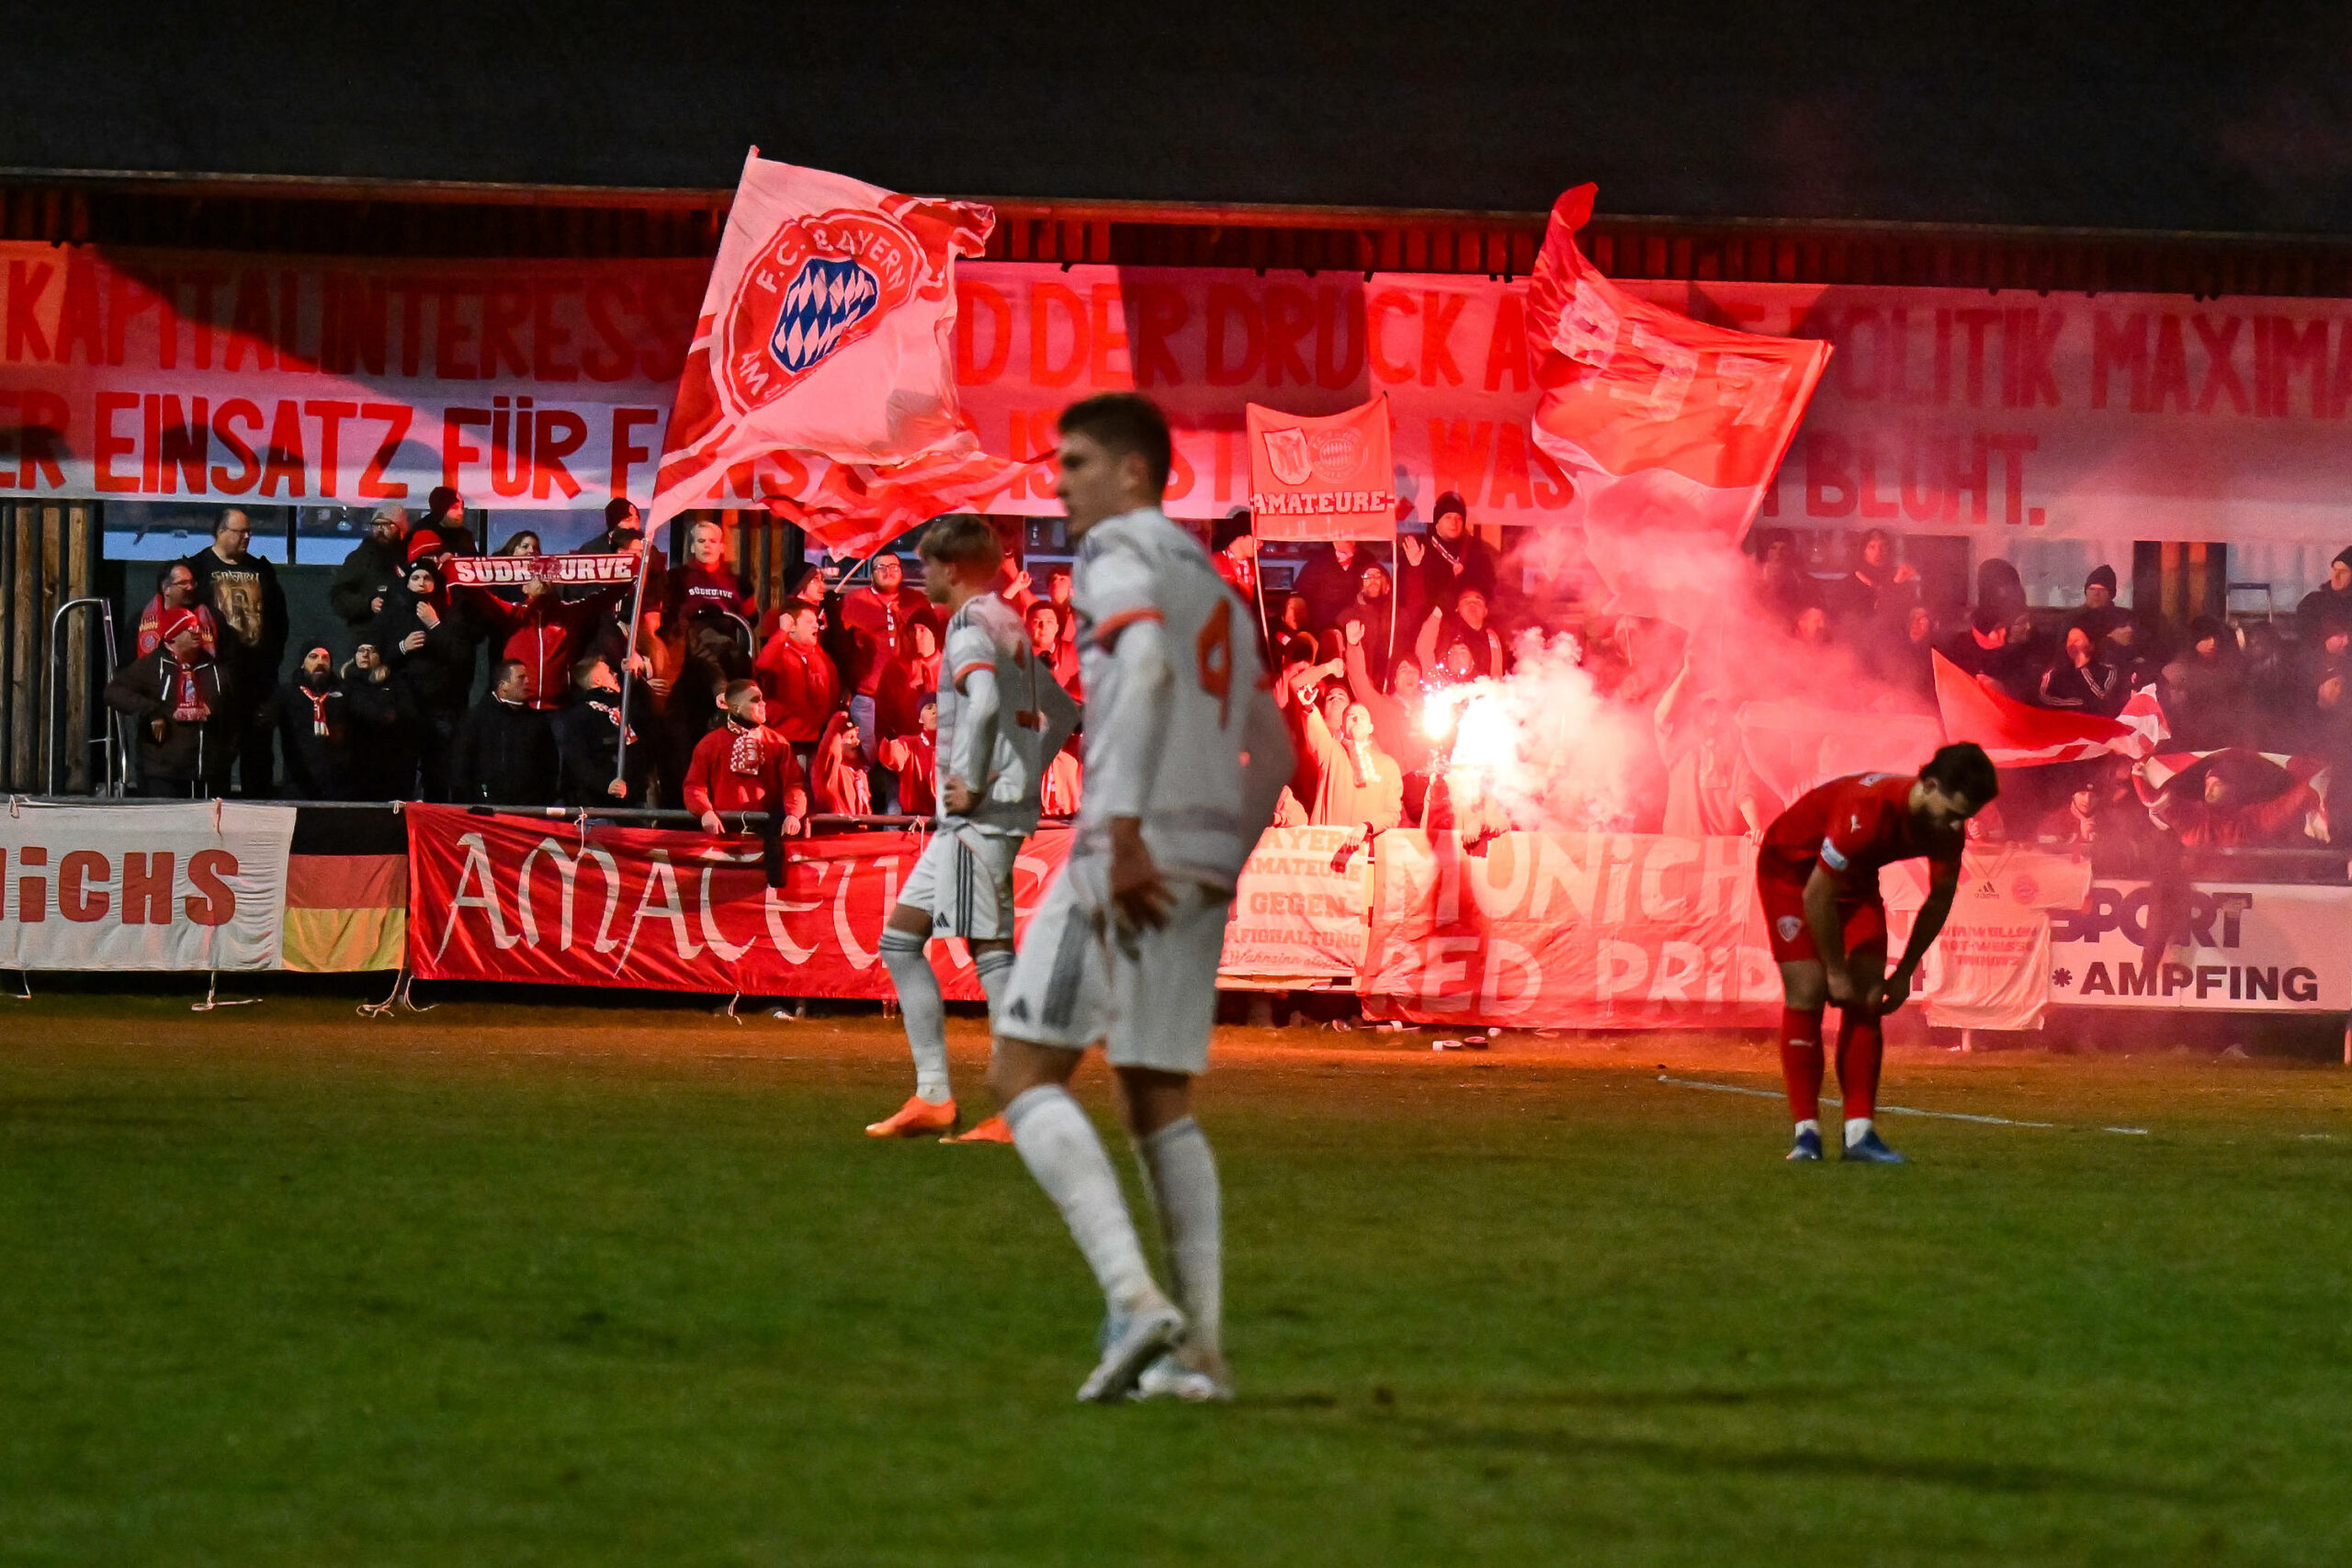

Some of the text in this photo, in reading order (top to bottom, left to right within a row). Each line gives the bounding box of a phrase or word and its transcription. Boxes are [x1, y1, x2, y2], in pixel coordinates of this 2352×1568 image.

[812, 229, 906, 291] BAYERN
[6, 258, 687, 383] KAPITALINTERESS
[1030, 281, 1189, 387] DER
[1204, 282, 1464, 390] DRUCK
[94, 391, 414, 500] EINSATZ
[442, 395, 589, 500] FÜR
[1252, 491, 1386, 515] AMATEURE
[1262, 829, 1367, 856] AYER
[0, 846, 239, 927] iCHS
[432, 833, 1049, 969] AMATEU
[1250, 892, 1347, 918] GEGEN
[1374, 935, 1785, 1017] RED PRiD
[2078, 961, 2319, 1002] AMPFING
